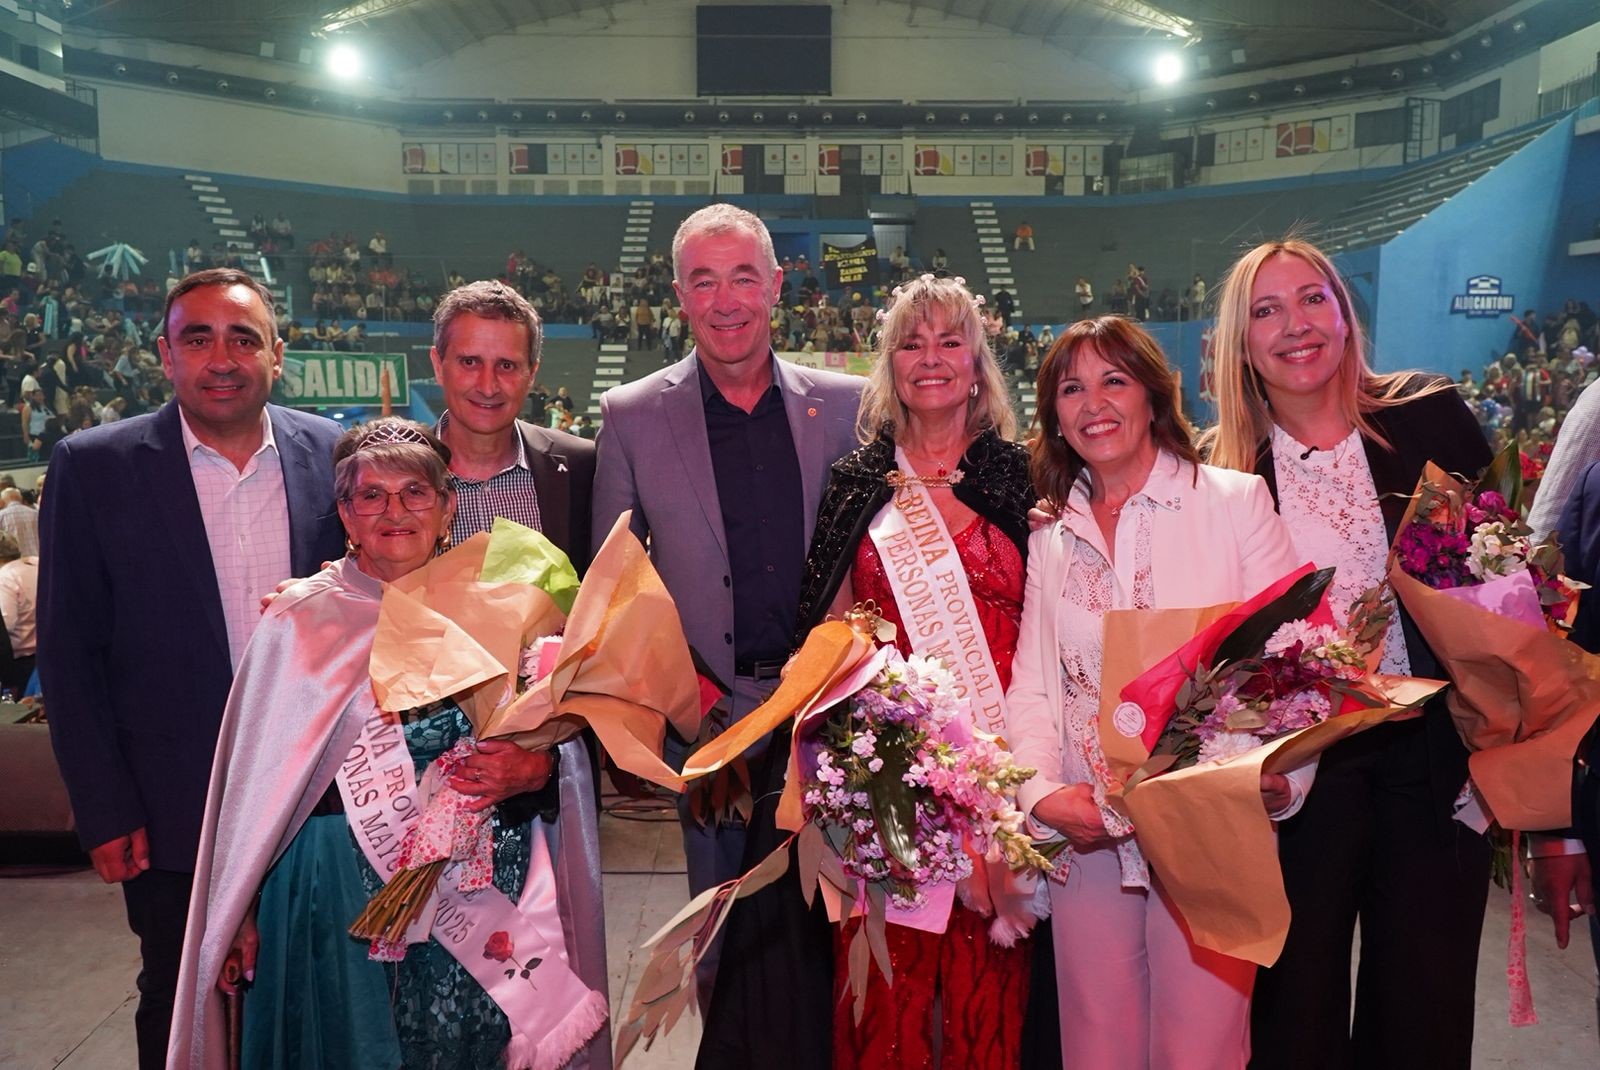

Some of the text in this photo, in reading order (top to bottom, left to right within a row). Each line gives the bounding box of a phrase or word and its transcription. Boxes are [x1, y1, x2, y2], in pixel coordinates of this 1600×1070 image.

[282, 358, 400, 398] SALIDA
[882, 531, 944, 637] PERSONAS
[897, 493, 1006, 733] REINA PROVINCIAL DE
[383, 764, 420, 826] PROV
[436, 898, 475, 944] 2025
